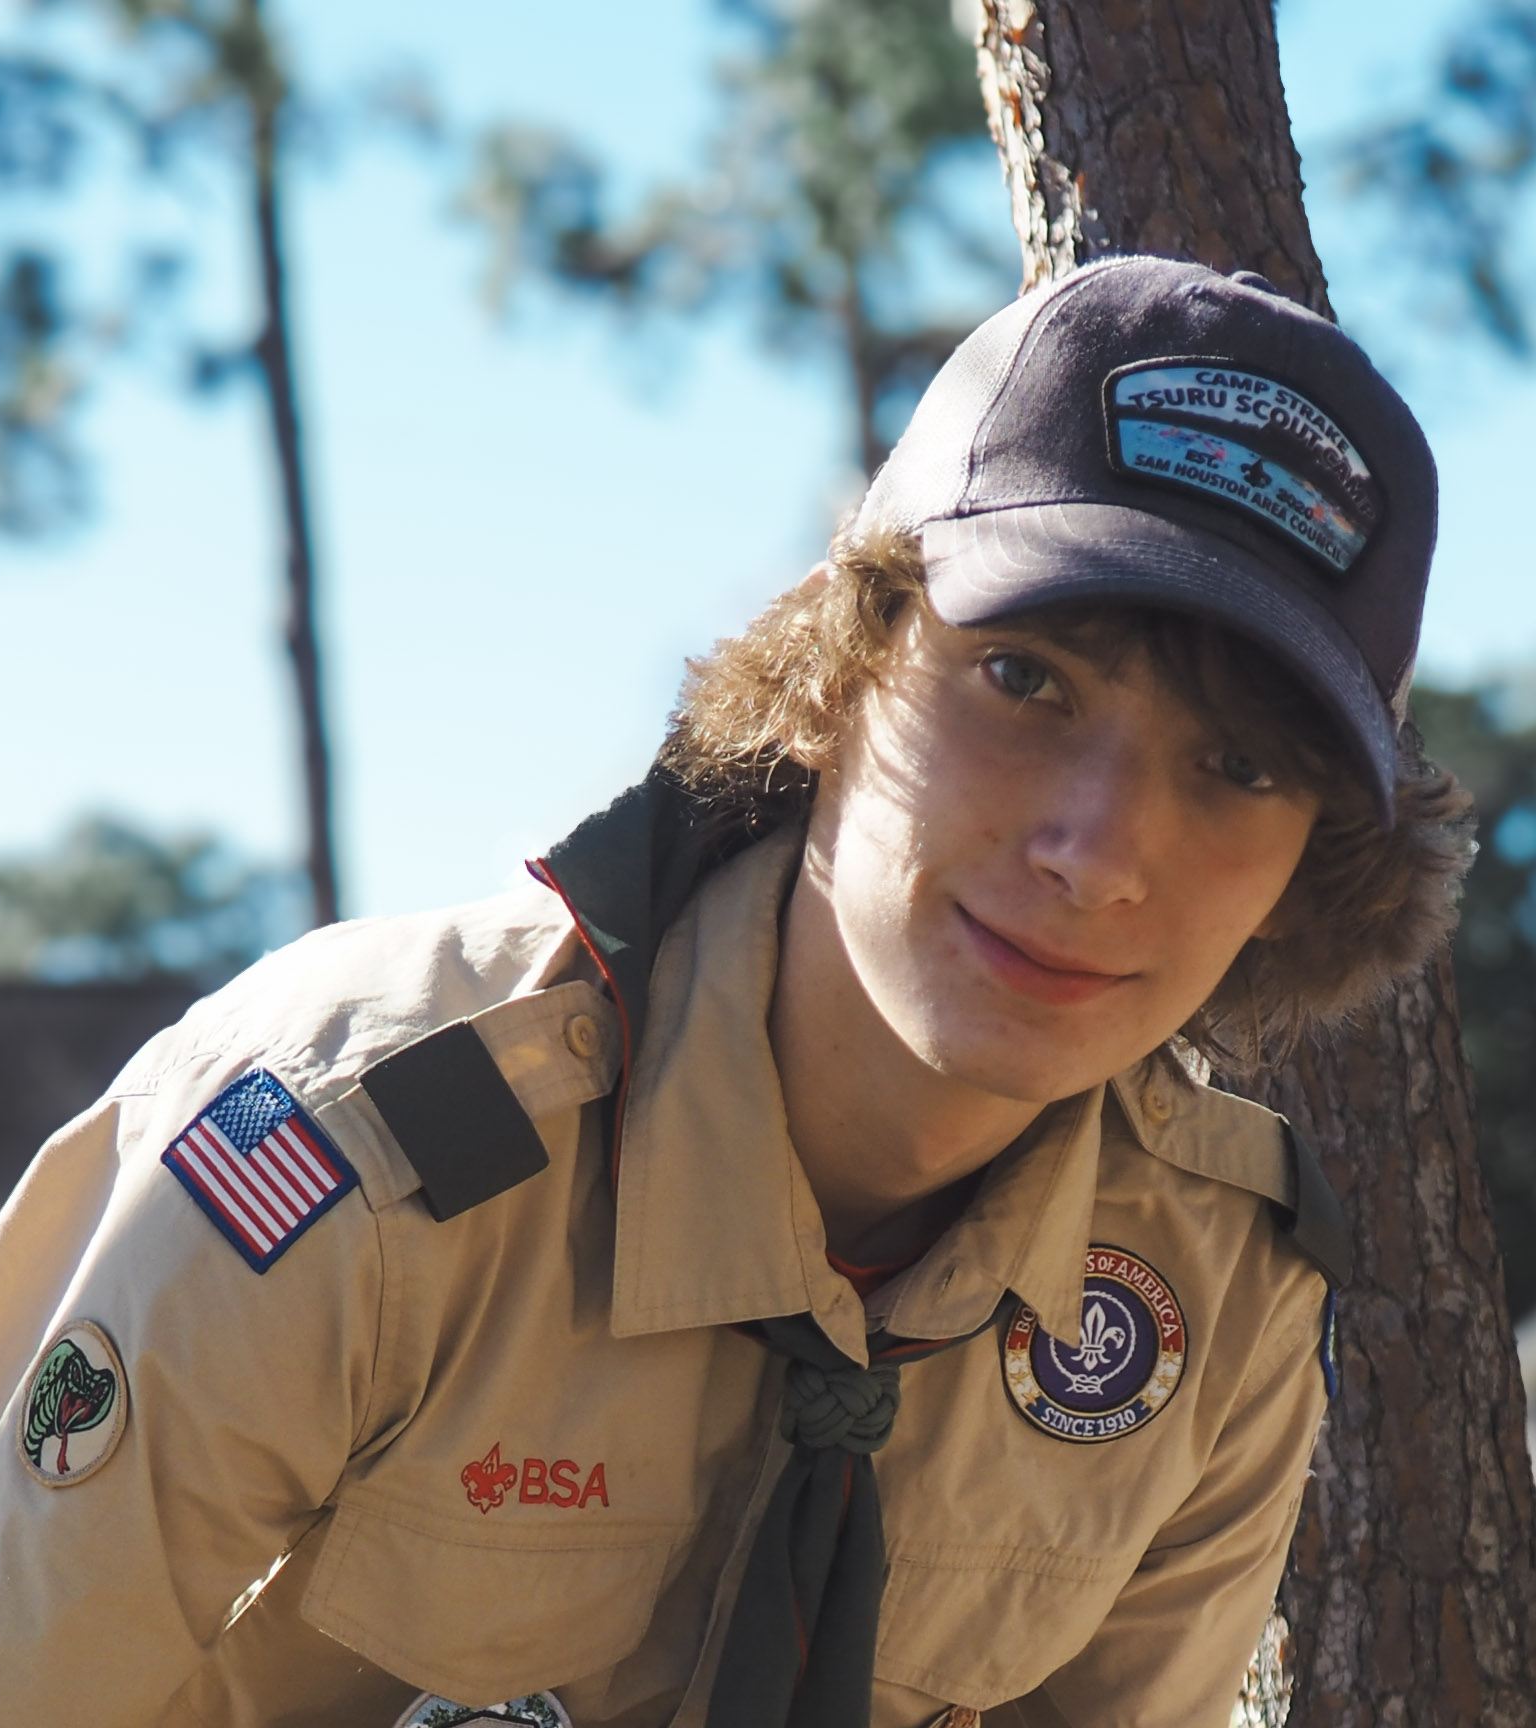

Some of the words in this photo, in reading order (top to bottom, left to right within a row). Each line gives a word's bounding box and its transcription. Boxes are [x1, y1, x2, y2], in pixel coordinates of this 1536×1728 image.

[1128, 387, 1227, 410] TSURU
[1235, 396, 1319, 447] SCOUT
[1319, 446, 1377, 521] CAMP
[1195, 371, 1270, 394] CAMP
[1276, 389, 1348, 454] STRAKE
[1134, 454, 1171, 473] SAM
[1173, 462, 1250, 504] HOUSTON
[1251, 491, 1287, 523] AREA
[1289, 516, 1343, 565] COUNCIL
[1184, 449, 1219, 469] EST.
[1276, 487, 1315, 520] 2020
[1098, 1254, 1115, 1272] OF
[1116, 1260, 1180, 1339] AMERICA
[1041, 1407, 1094, 1436] SINCE
[1097, 1408, 1137, 1435] 1910
[519, 1458, 610, 1509] BSA
